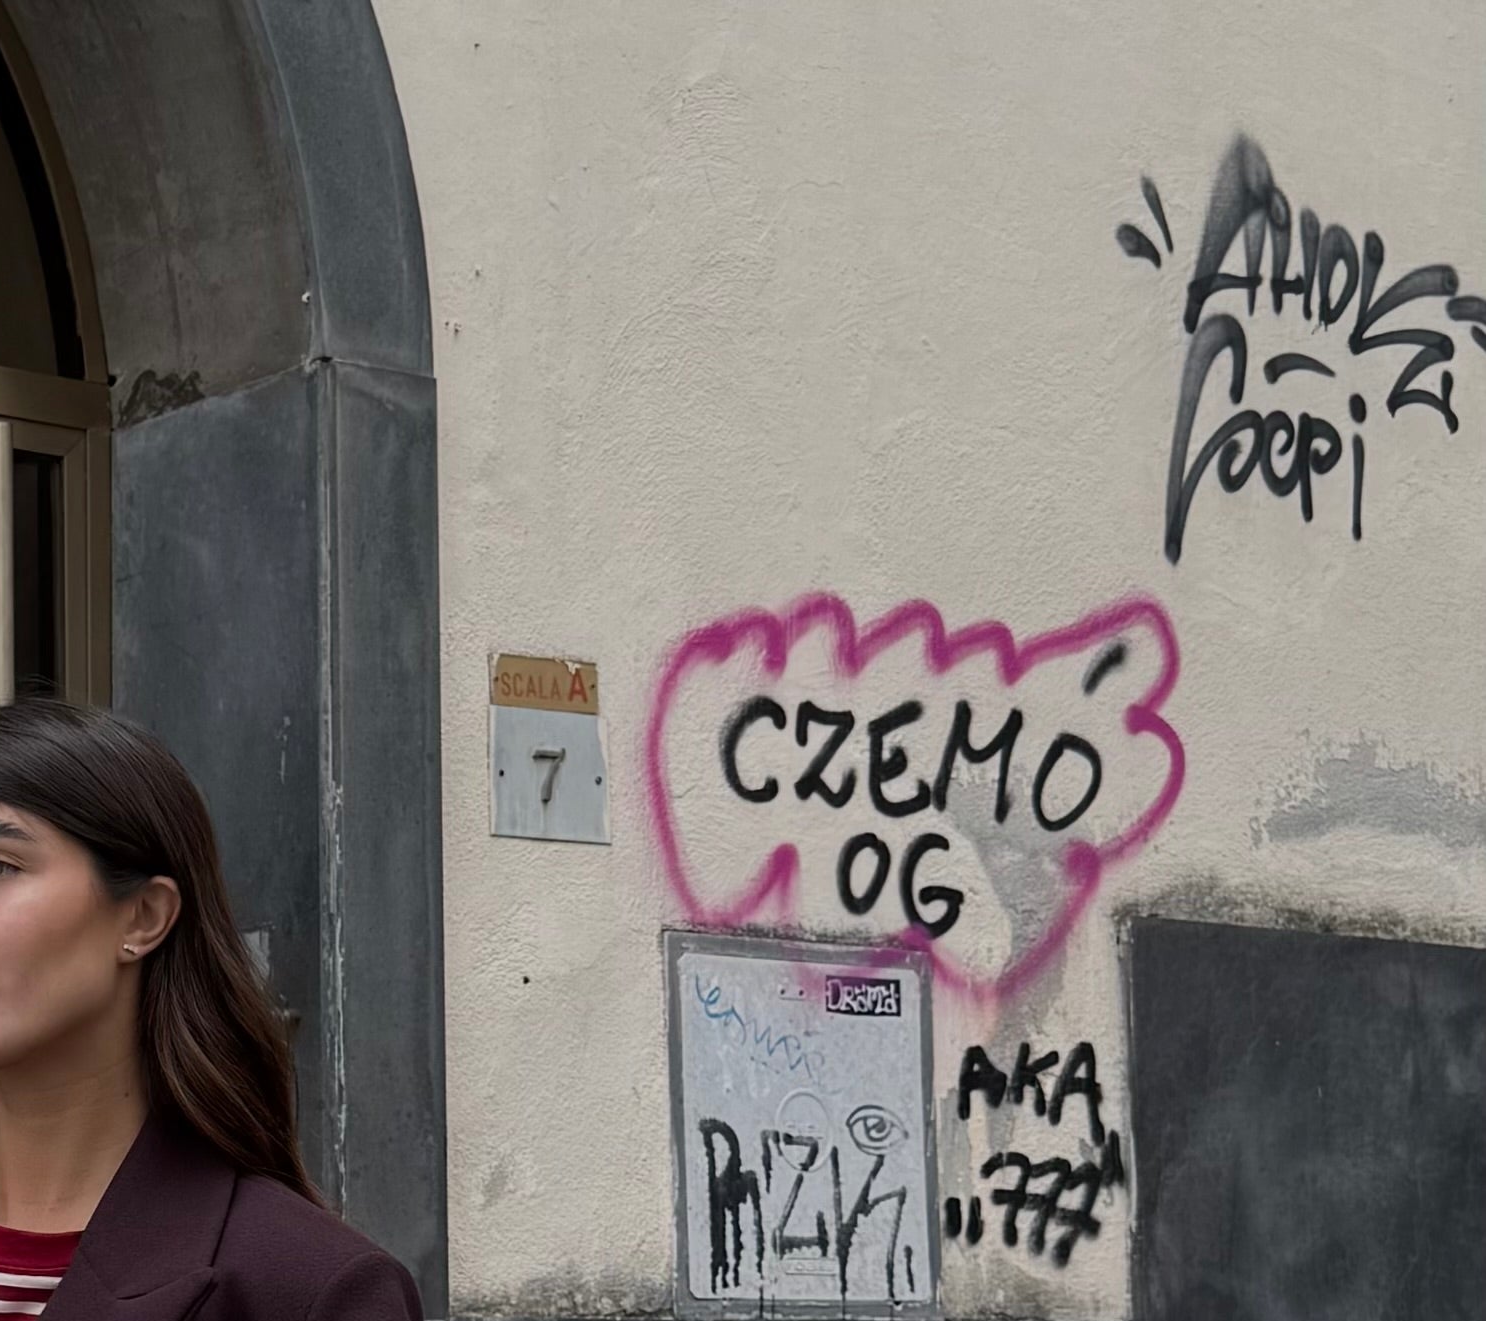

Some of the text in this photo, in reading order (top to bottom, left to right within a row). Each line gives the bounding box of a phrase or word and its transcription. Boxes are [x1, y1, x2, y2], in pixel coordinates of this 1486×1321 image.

[500, 668, 589, 704] SCALA A
[531, 747, 567, 805] 7
[836, 832, 965, 940] OG
[957, 1041, 1106, 1147] AKA
